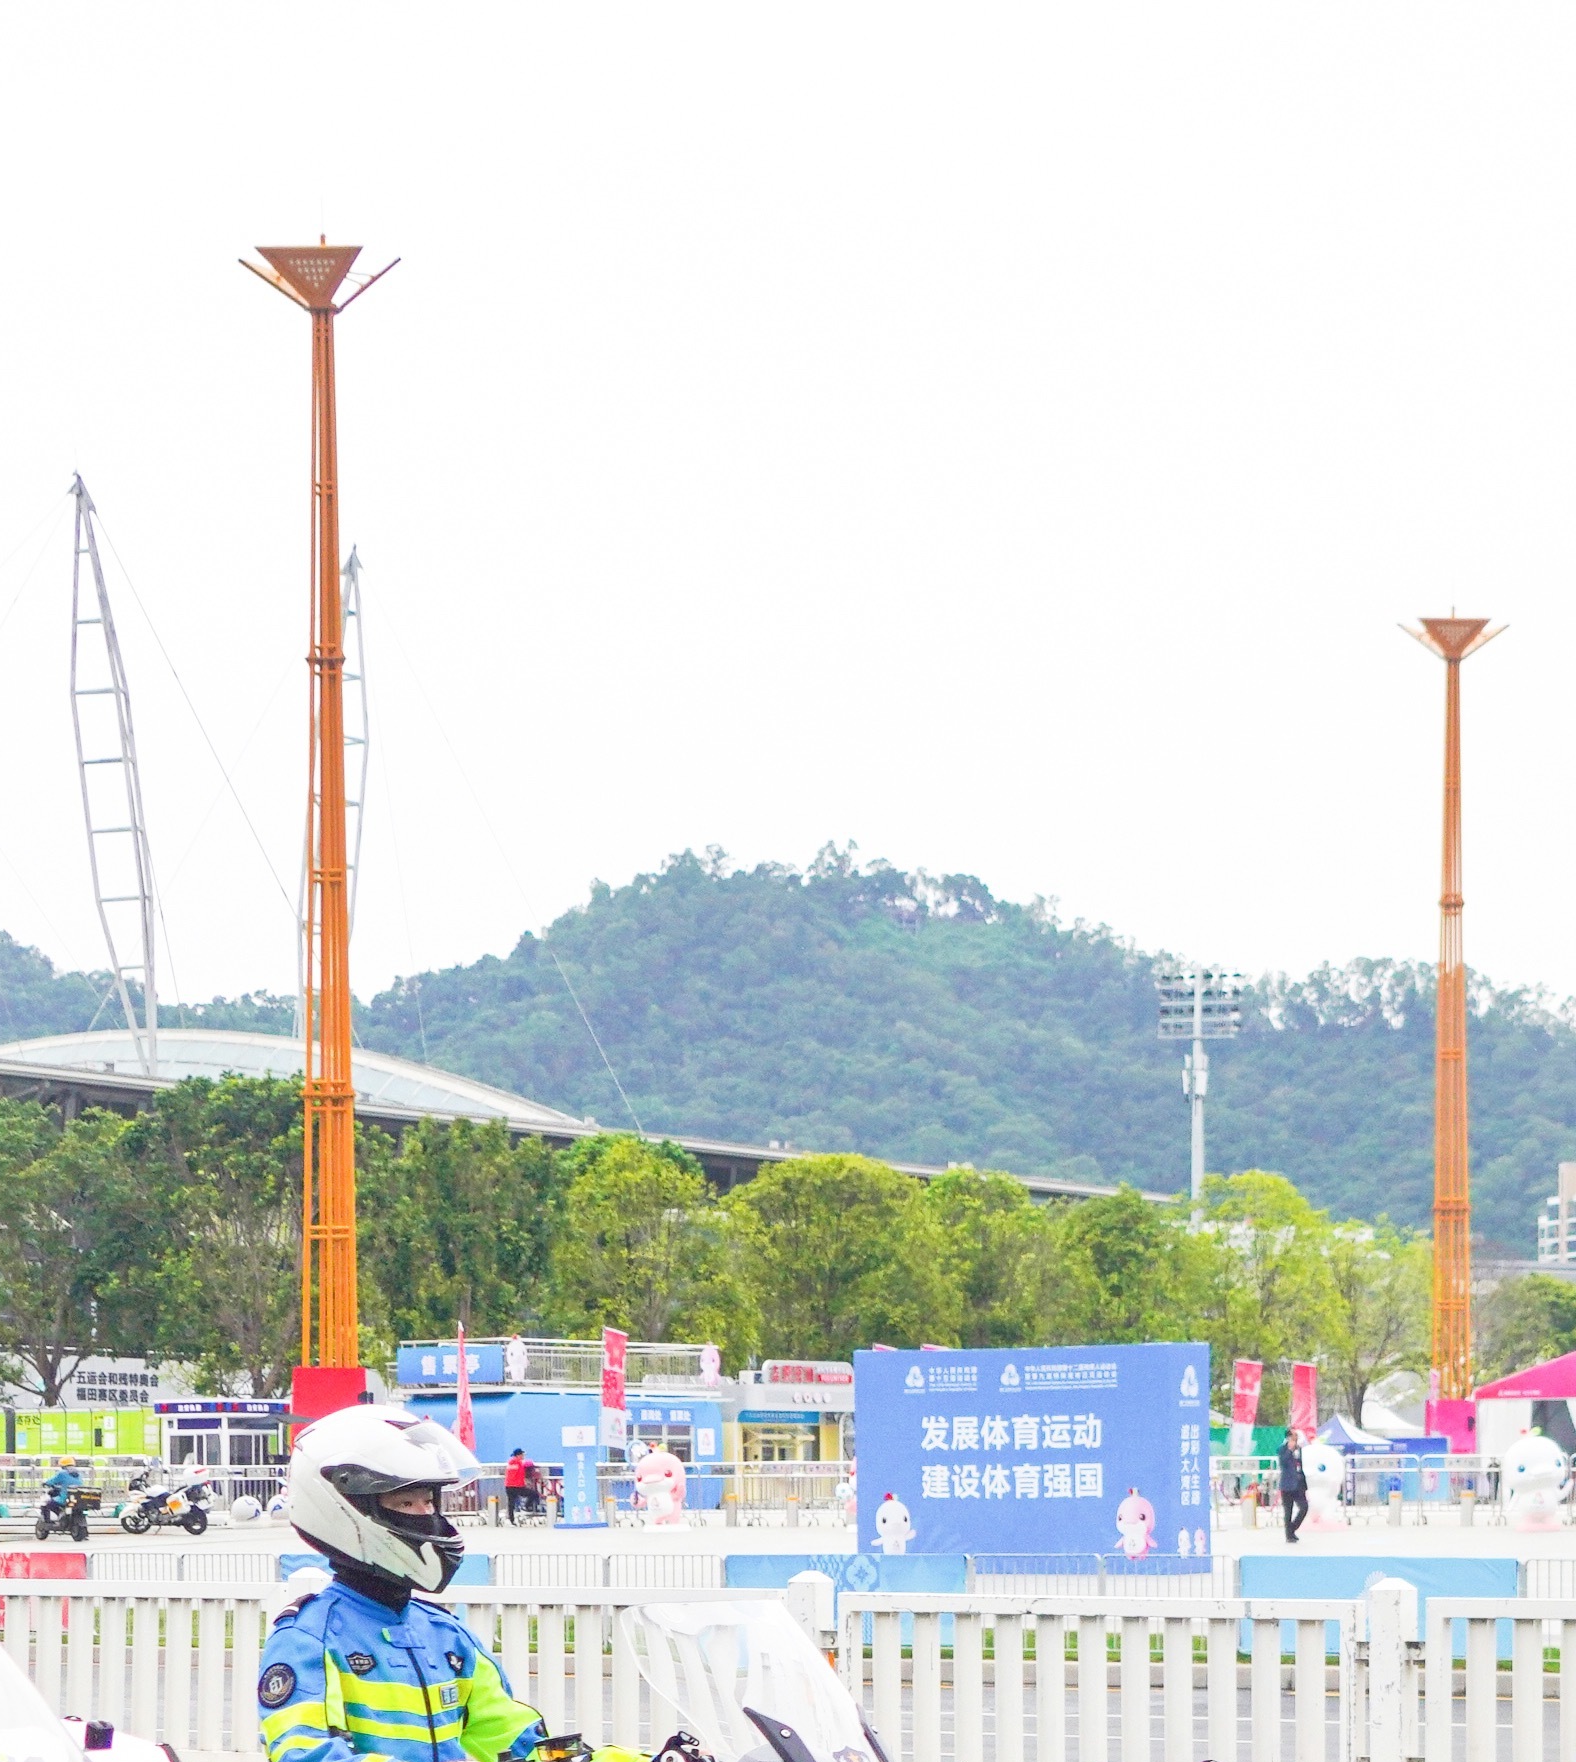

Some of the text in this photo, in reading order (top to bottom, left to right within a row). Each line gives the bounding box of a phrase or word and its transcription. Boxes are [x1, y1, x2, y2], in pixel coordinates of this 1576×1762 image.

[922, 1413, 1103, 1451] 发展体育运动
[922, 1462, 1104, 1500] 建设体育强国
